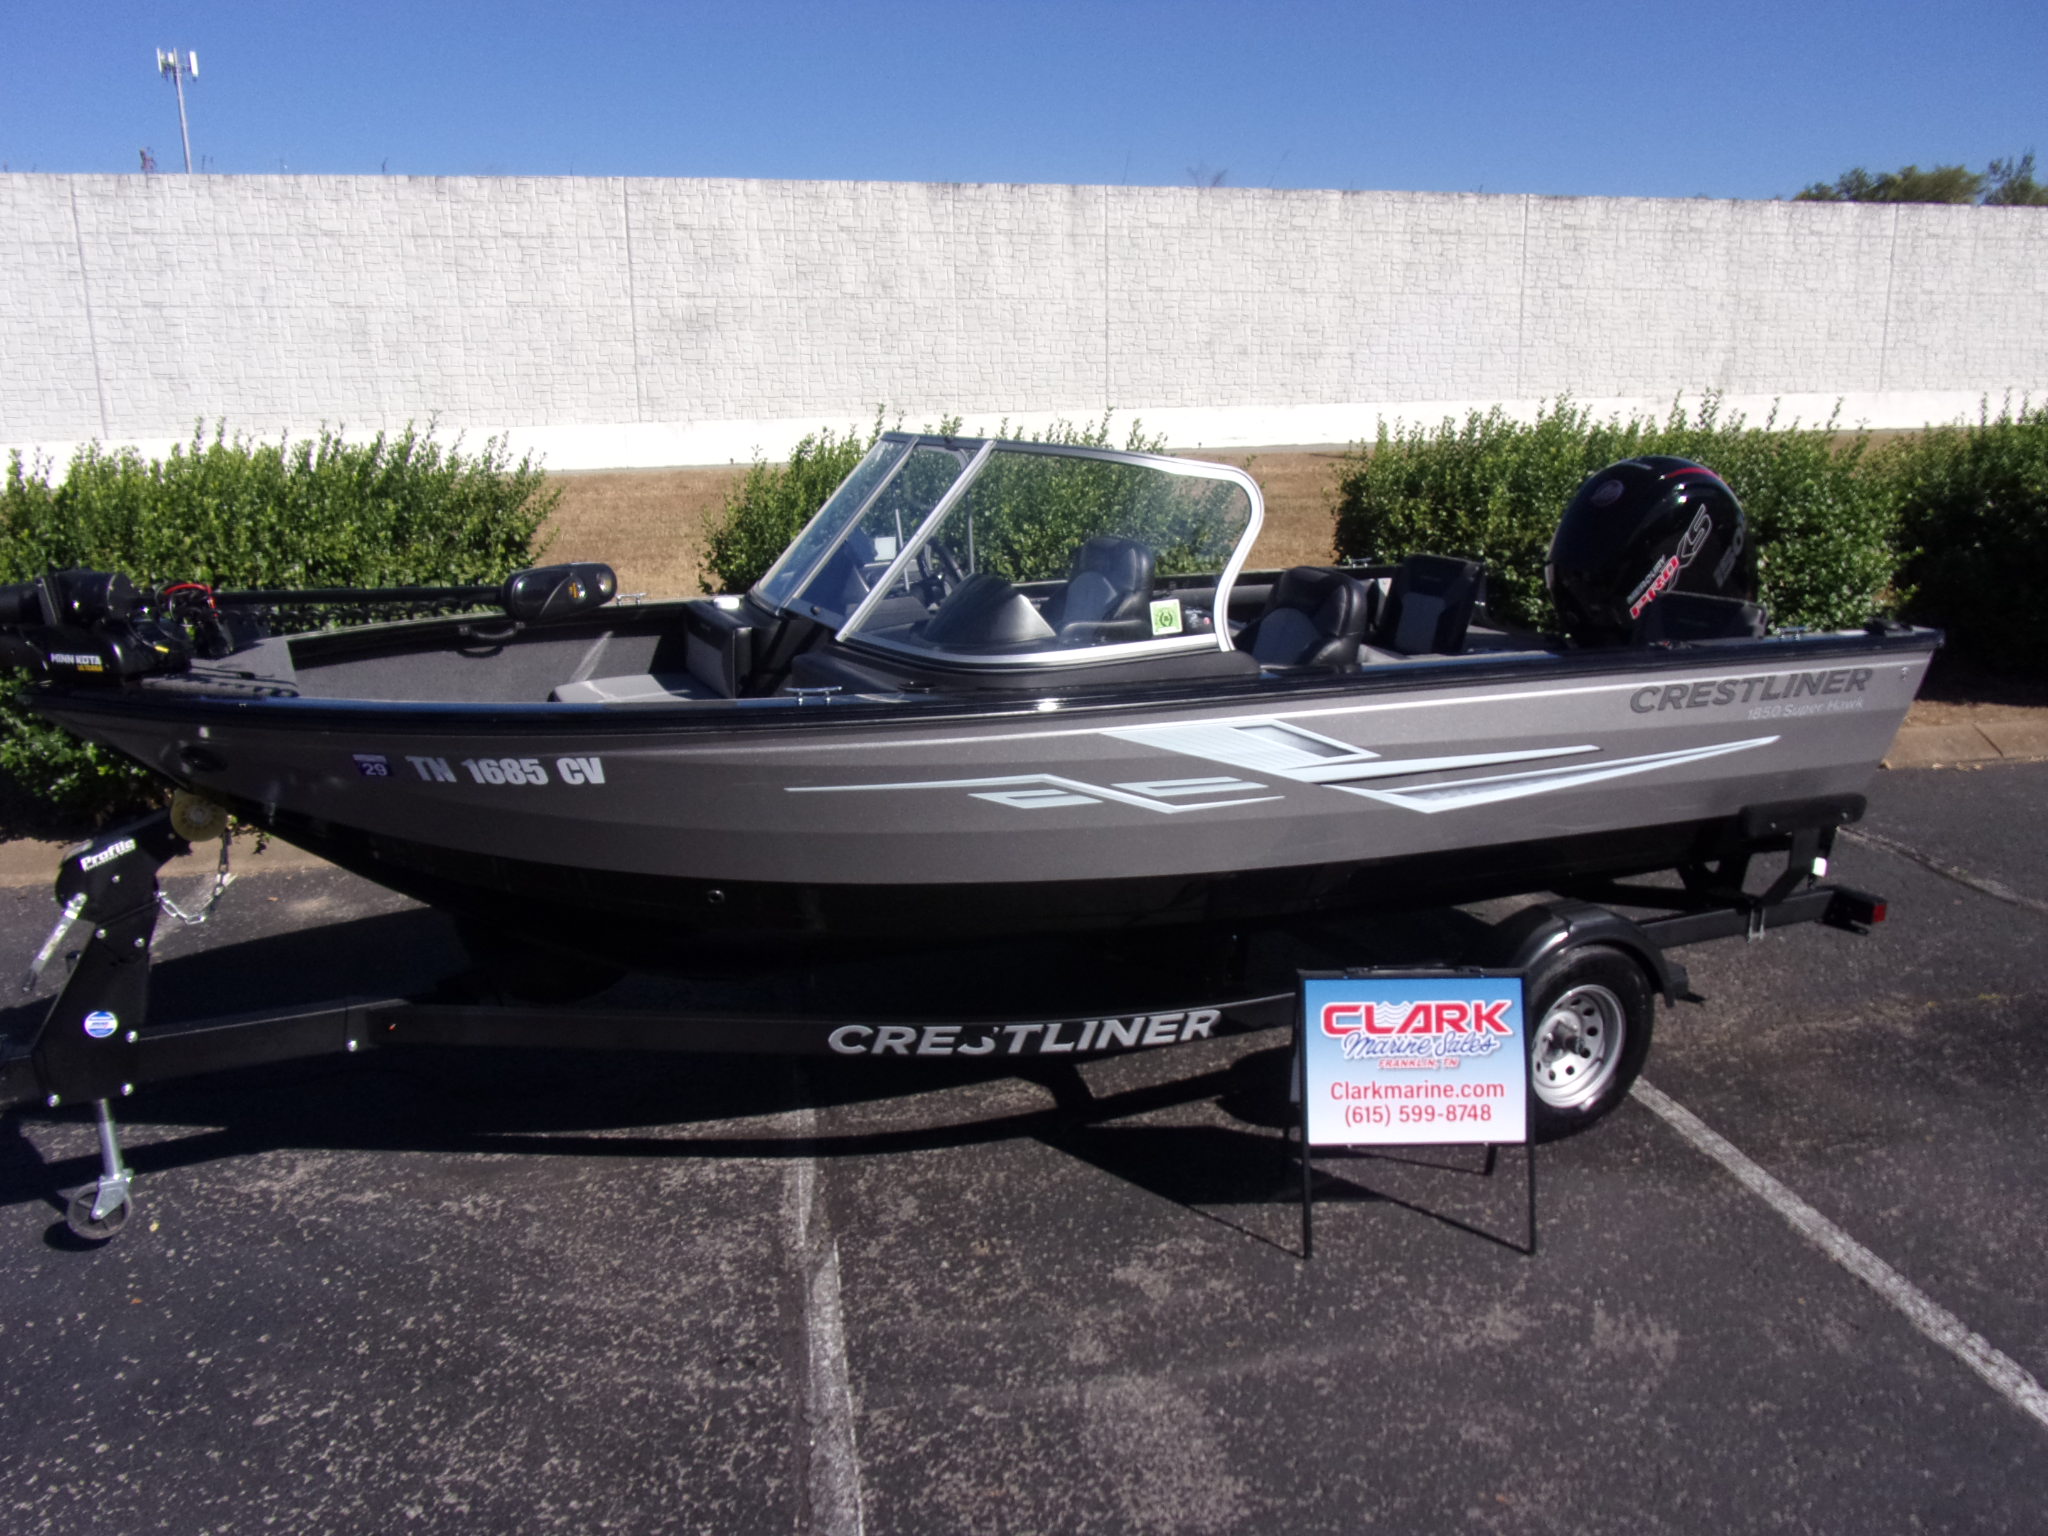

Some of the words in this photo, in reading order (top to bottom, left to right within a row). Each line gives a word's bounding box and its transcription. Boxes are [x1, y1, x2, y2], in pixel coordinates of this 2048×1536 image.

[75, 655, 102, 665] KOTA
[1629, 668, 1874, 714] CRESTLINER
[404, 755, 457, 782] TN
[461, 758, 549, 785] 1685
[556, 757, 606, 785] CV
[80, 838, 136, 871] Profile
[1322, 1001, 1512, 1035] CLARK
[1344, 1032, 1432, 1058] Marine
[1434, 1031, 1500, 1057] Sales
[1330, 1080, 1505, 1101] Clarkmarine.com
[1345, 1105, 1391, 1127] (615)
[1399, 1103, 1492, 1123] 599-8748
